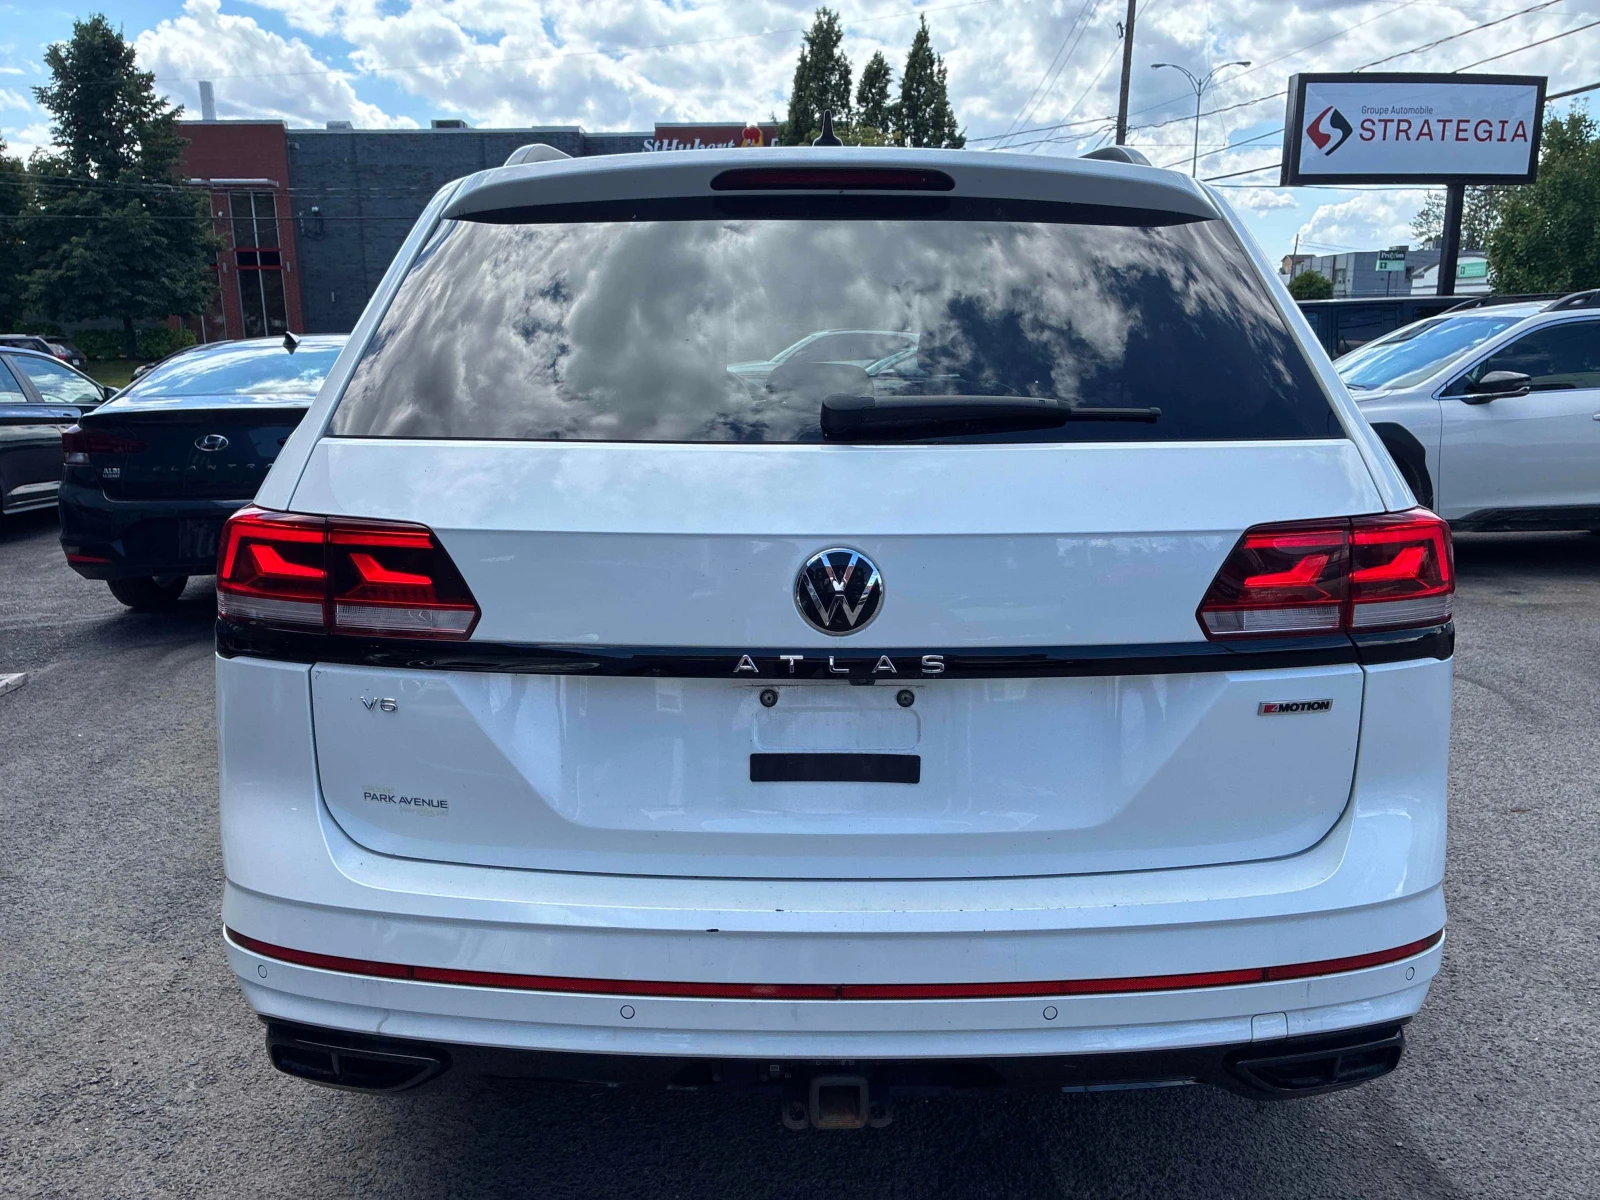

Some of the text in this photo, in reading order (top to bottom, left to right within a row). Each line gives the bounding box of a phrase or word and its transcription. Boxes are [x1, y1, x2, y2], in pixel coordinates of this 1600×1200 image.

[1361, 105, 1433, 116] Groupe Automobile
[1359, 118, 1528, 143] STRATEGIA
[733, 654, 945, 674] ATLAS
[360, 696, 398, 712] V6
[364, 791, 449, 809] PARK AVENUE
